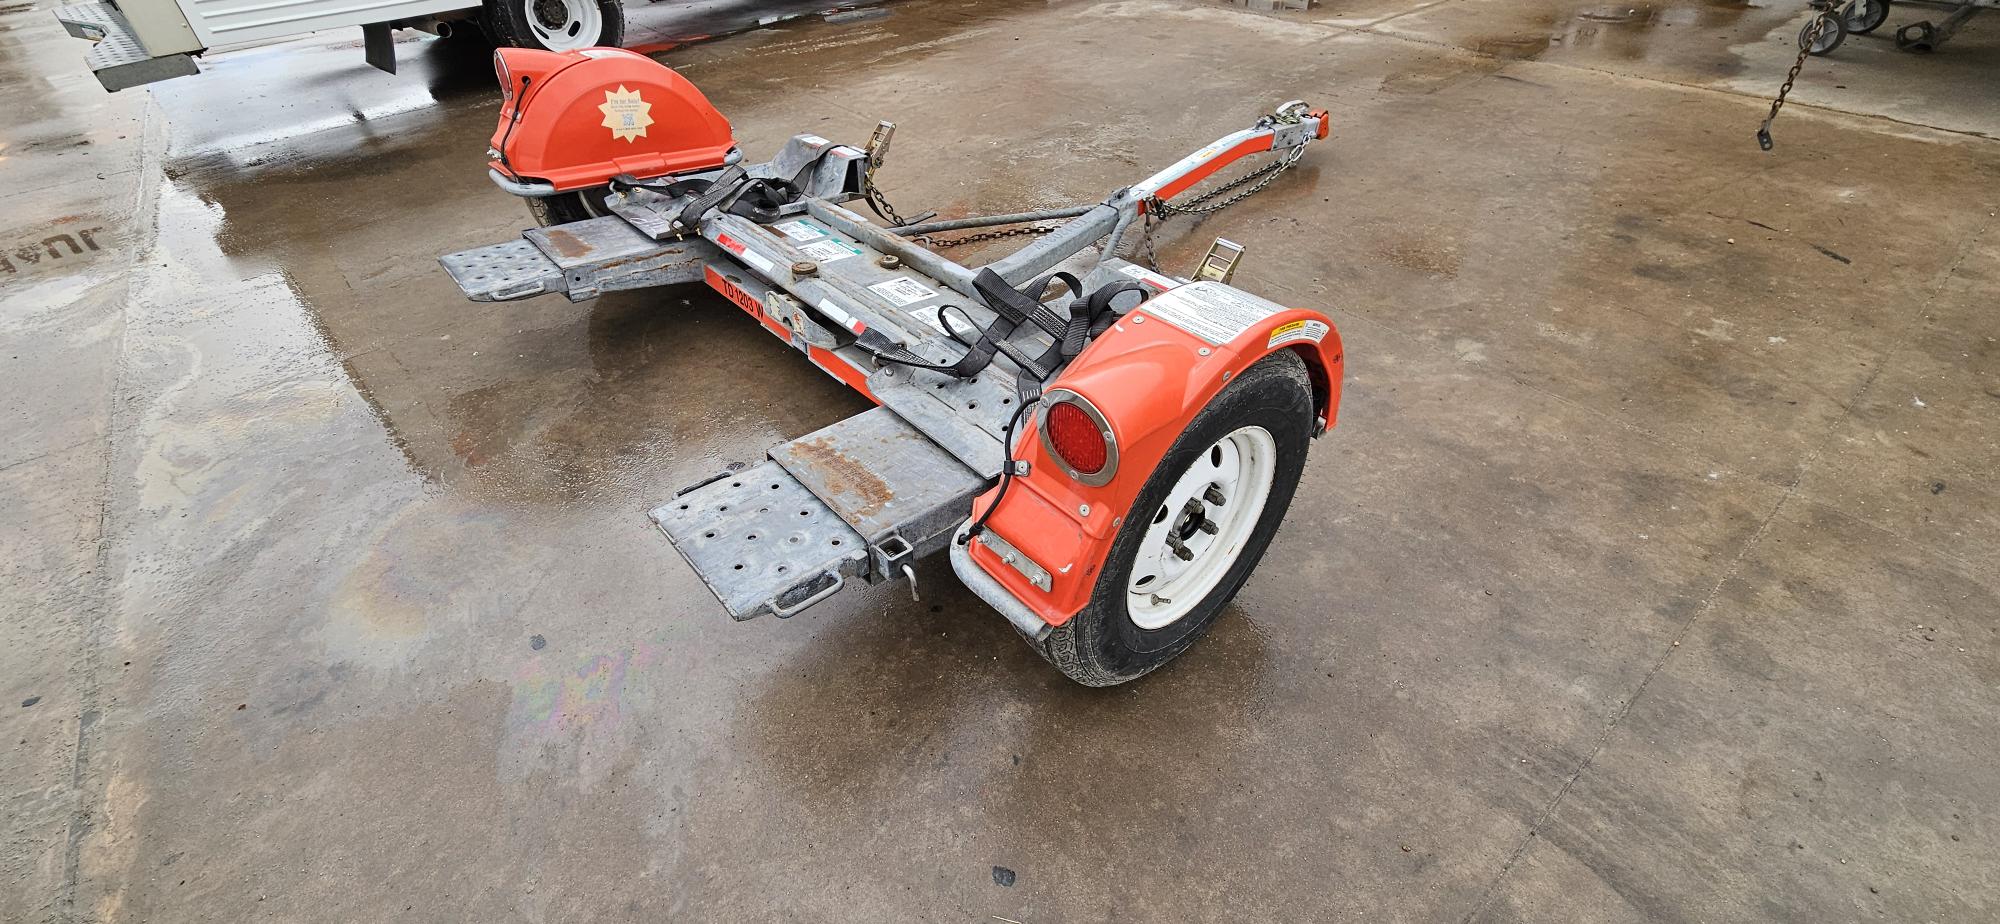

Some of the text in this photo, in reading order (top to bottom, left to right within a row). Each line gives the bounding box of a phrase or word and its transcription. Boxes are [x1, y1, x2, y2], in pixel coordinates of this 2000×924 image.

[721, 278, 764, 320] TD 1203 W
